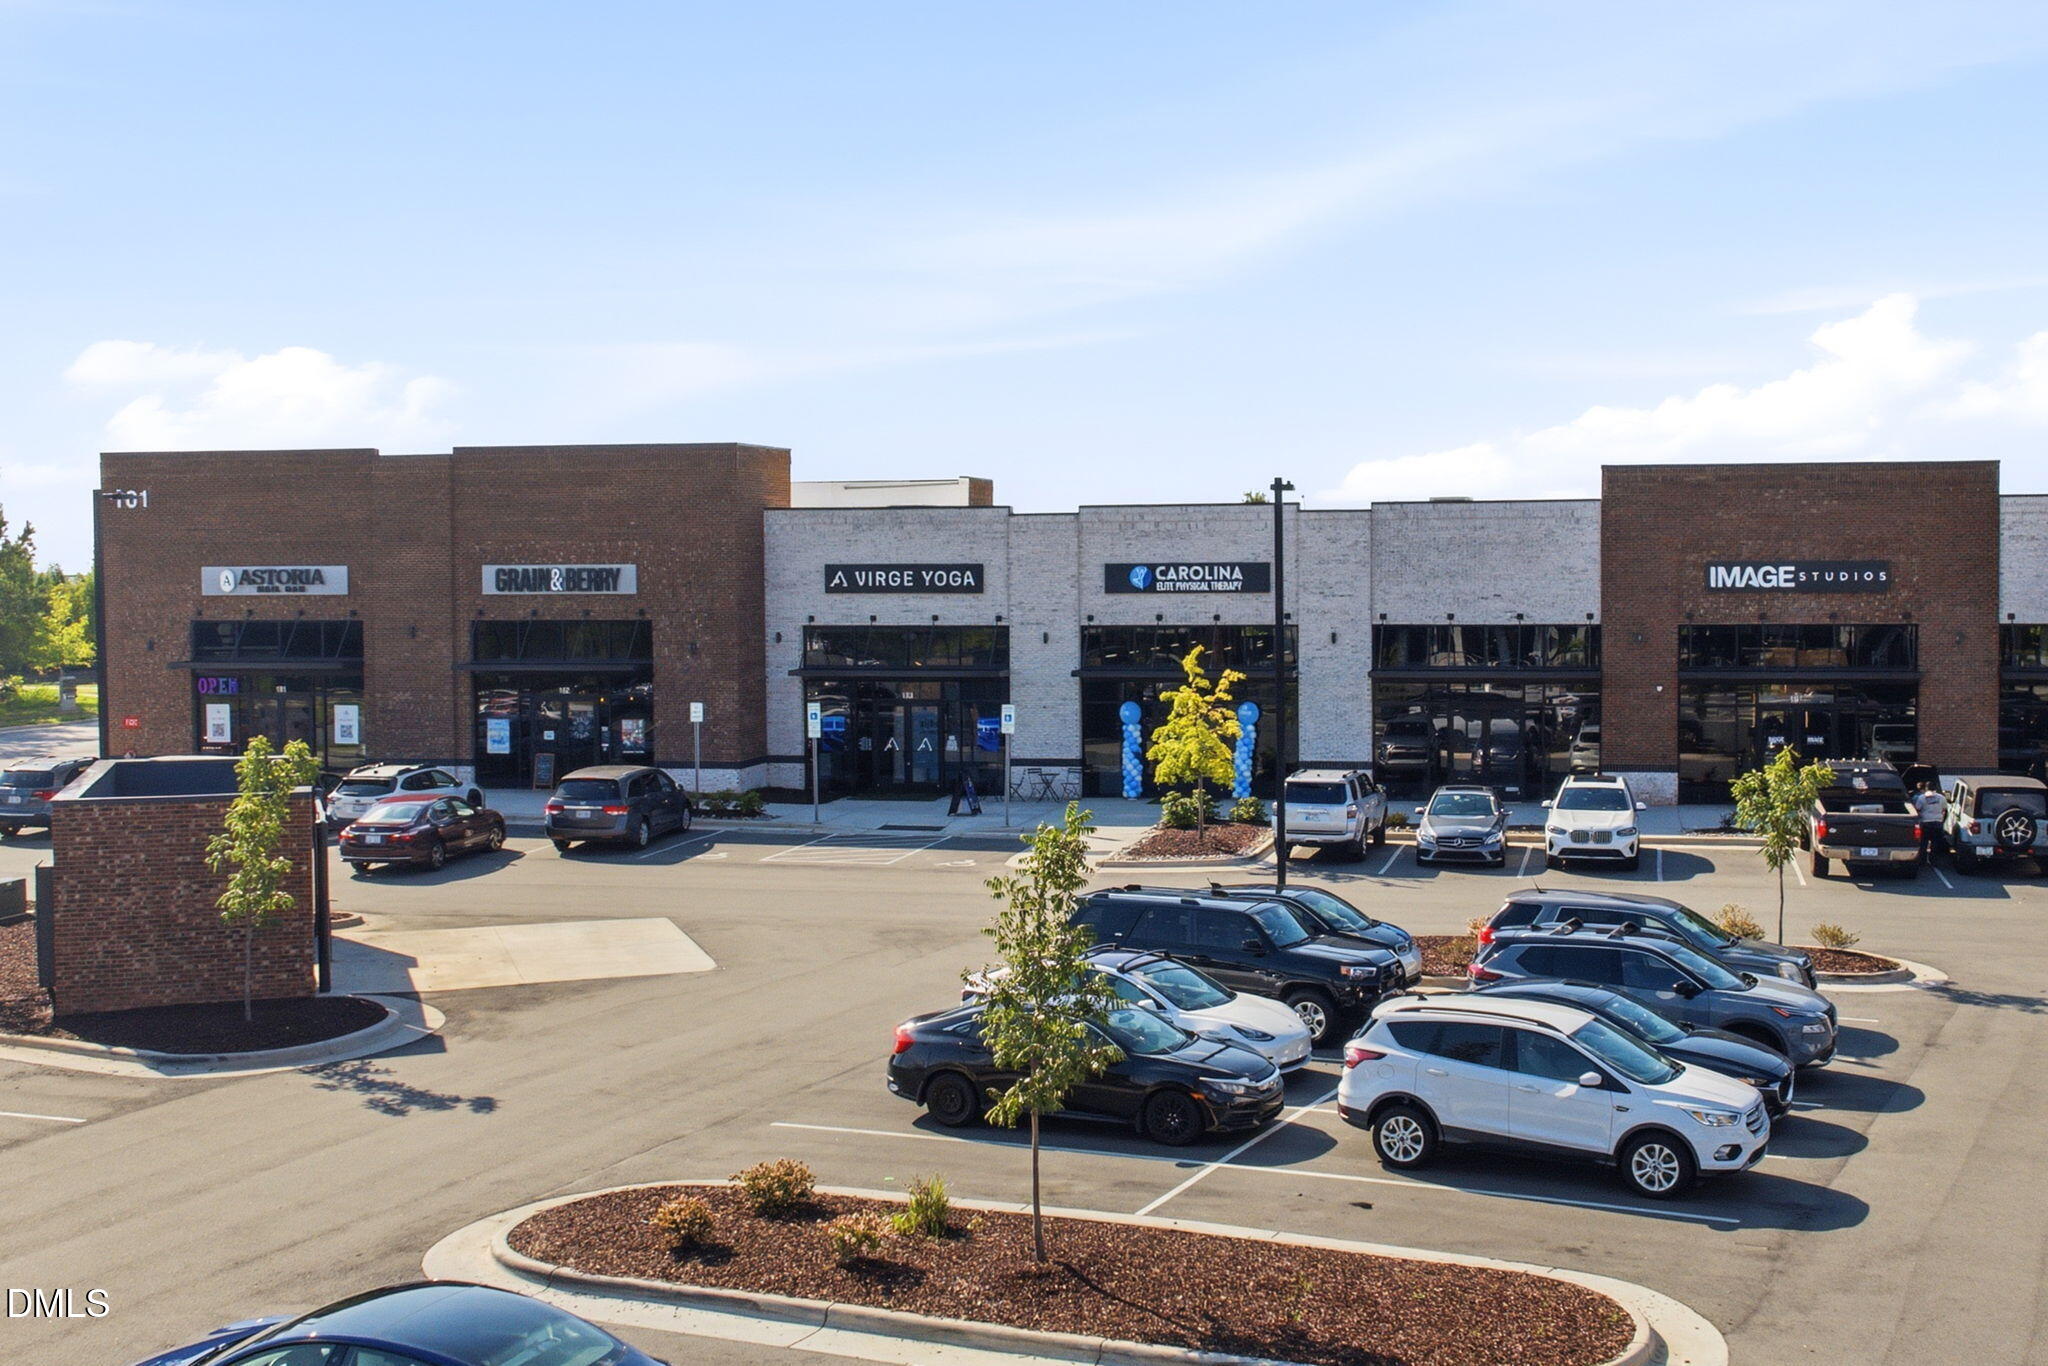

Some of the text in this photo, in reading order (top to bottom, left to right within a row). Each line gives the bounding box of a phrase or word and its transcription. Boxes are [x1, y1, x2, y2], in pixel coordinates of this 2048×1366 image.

[239, 568, 325, 585] ASTORIA
[854, 570, 976, 587] VIRGE YOGA
[1155, 565, 1244, 581] CAROLINA
[1709, 565, 1887, 588] IMAGE STUDIOS
[198, 677, 240, 695] OPEN
